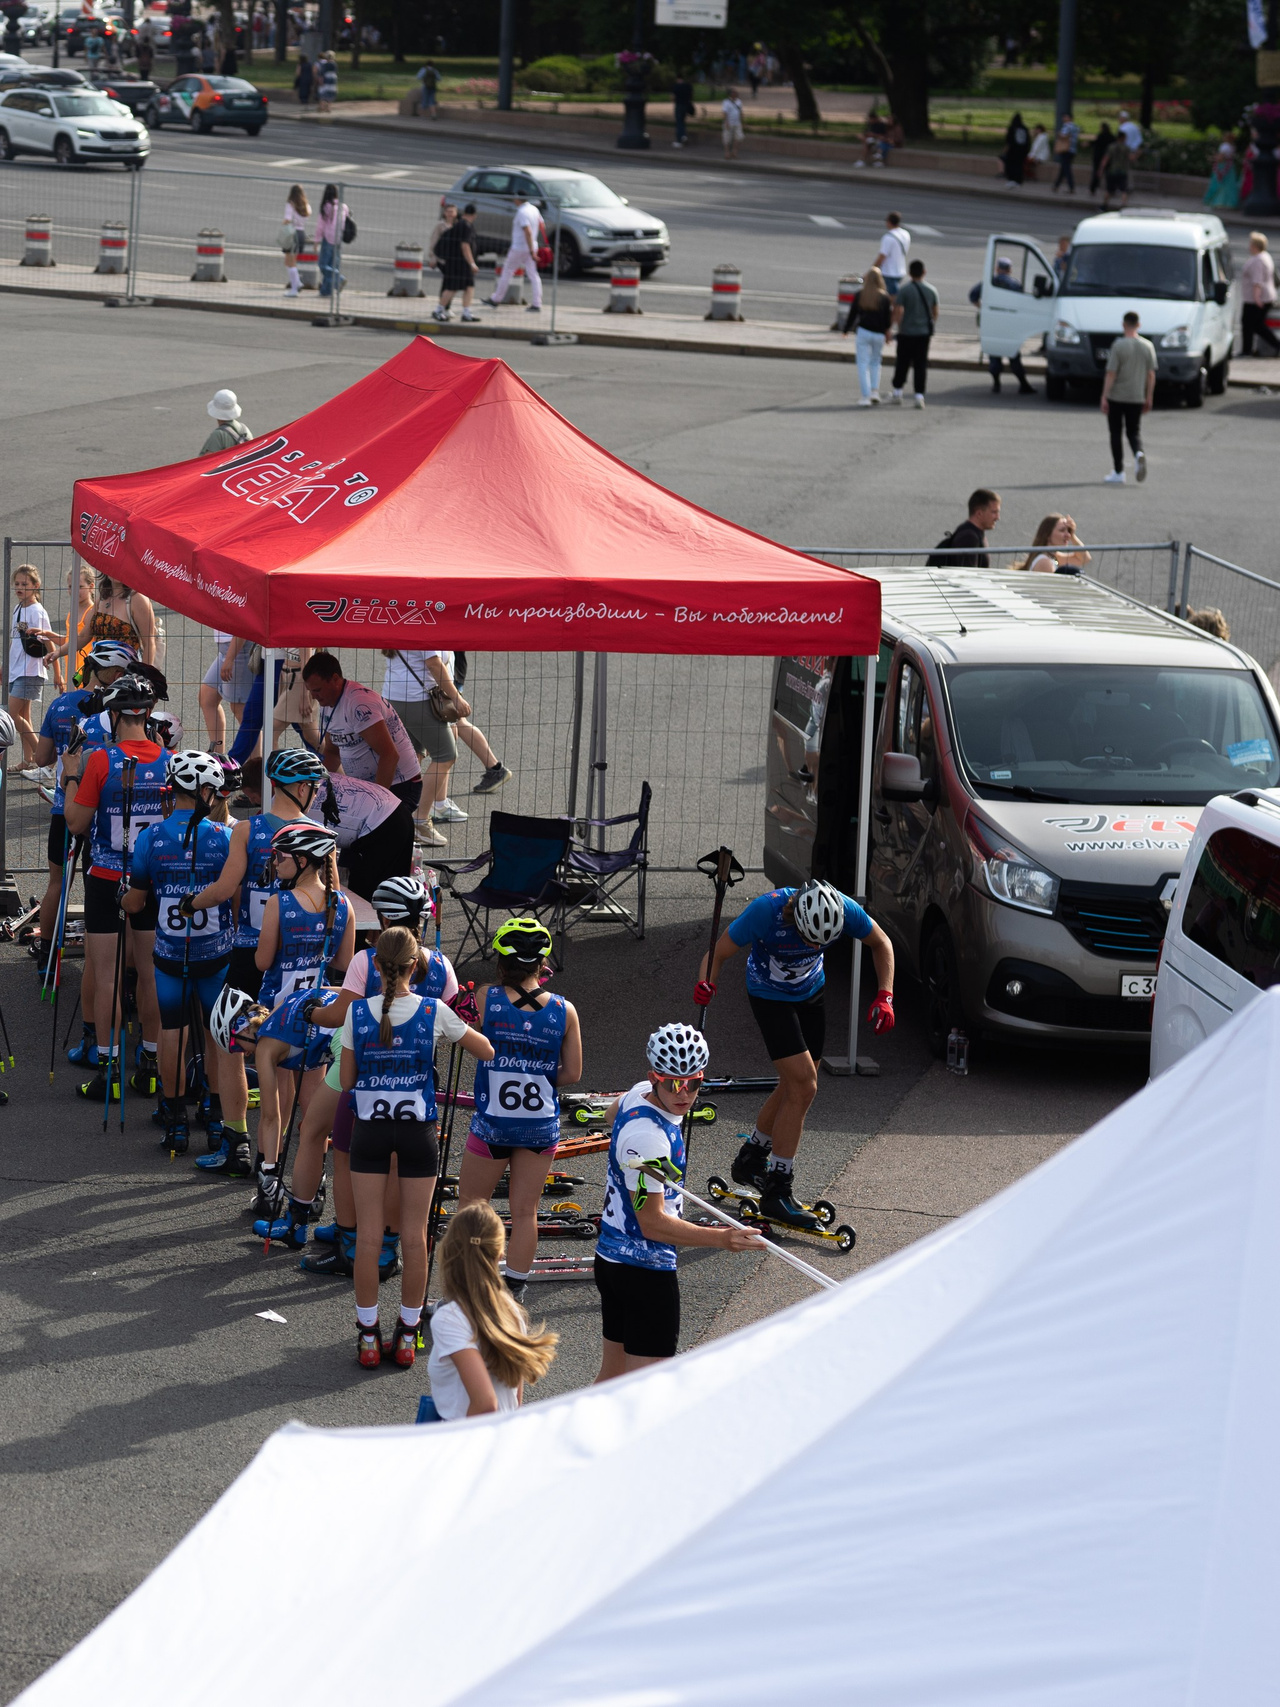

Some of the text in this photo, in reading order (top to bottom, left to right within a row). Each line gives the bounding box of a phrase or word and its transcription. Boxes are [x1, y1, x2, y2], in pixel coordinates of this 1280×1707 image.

[280, 450, 369, 486] SPT
[352, 599, 433, 607] SPORT
[464, 604, 503, 619] Мы
[508, 602, 648, 623] производим
[673, 606, 707, 623] Вы
[712, 607, 844, 624] побеждаете!
[1065, 838, 1191, 852] www.elva-
[167, 903, 208, 930] 80
[498, 1080, 544, 1112] 68
[370, 1098, 417, 1121] 86
